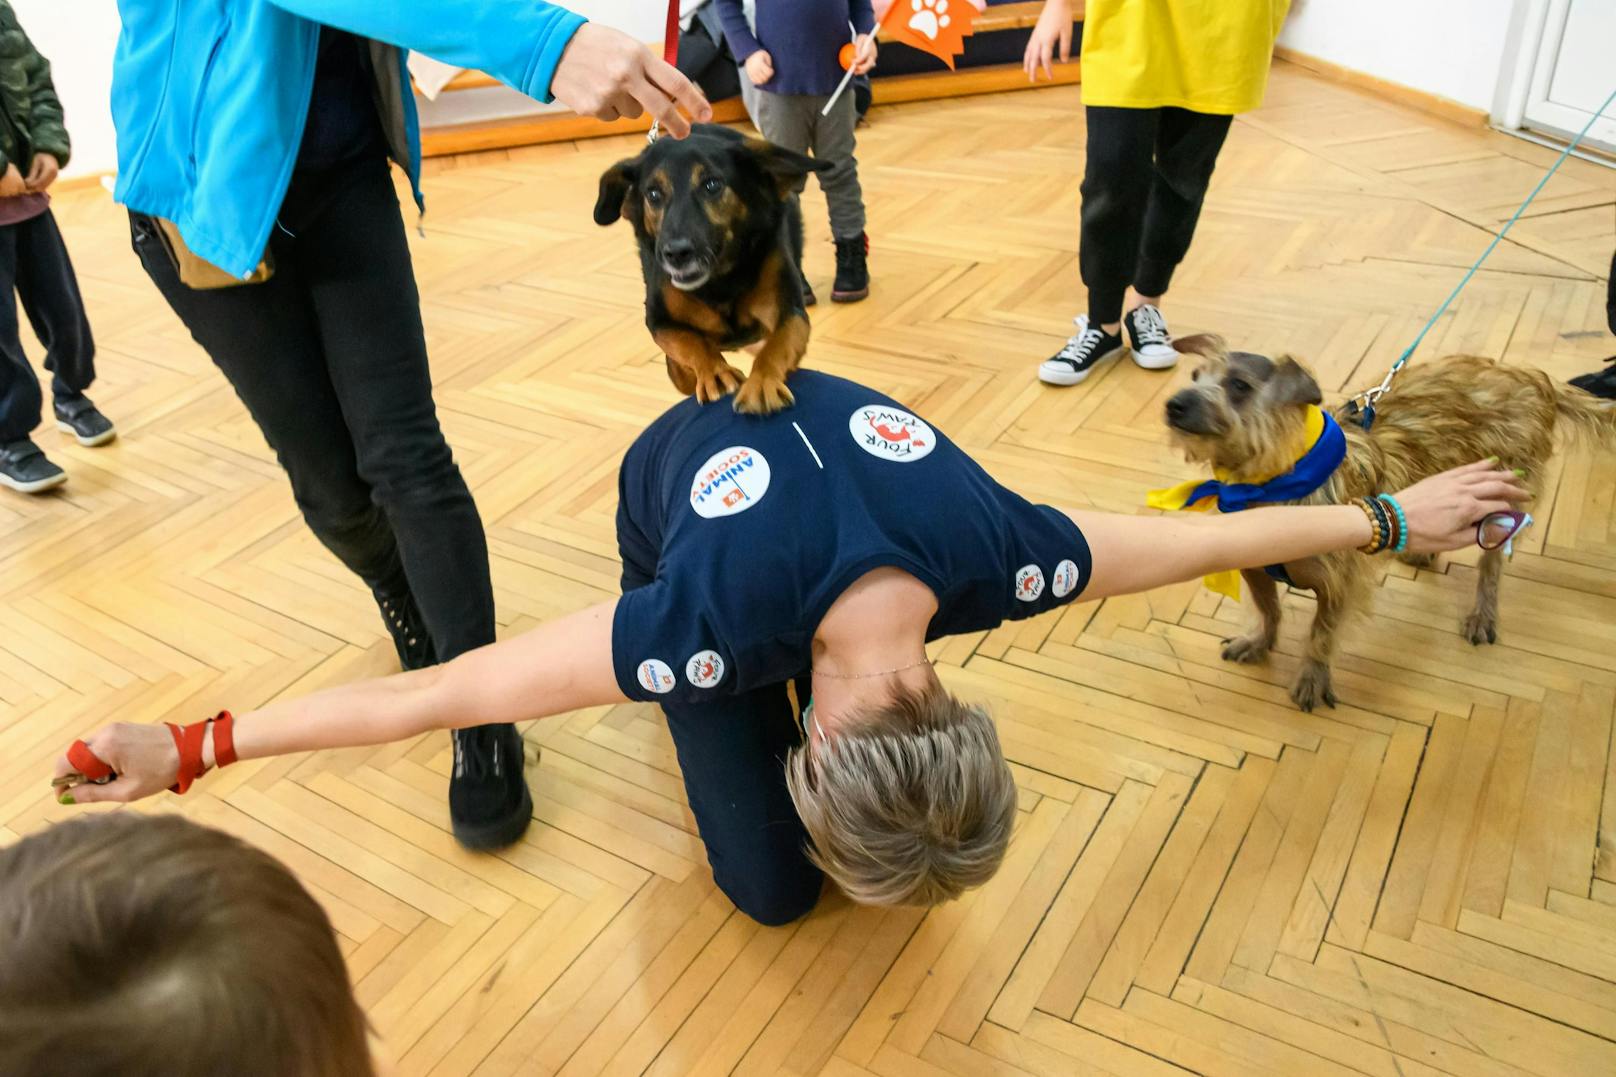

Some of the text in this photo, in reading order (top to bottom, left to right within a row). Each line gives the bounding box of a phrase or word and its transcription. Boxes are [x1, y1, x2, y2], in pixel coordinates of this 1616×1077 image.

[863, 410, 920, 427] PAWS
[865, 433, 912, 457] FOUR
[692, 450, 750, 500] SOCIETY
[695, 456, 754, 503] ANIMAL
